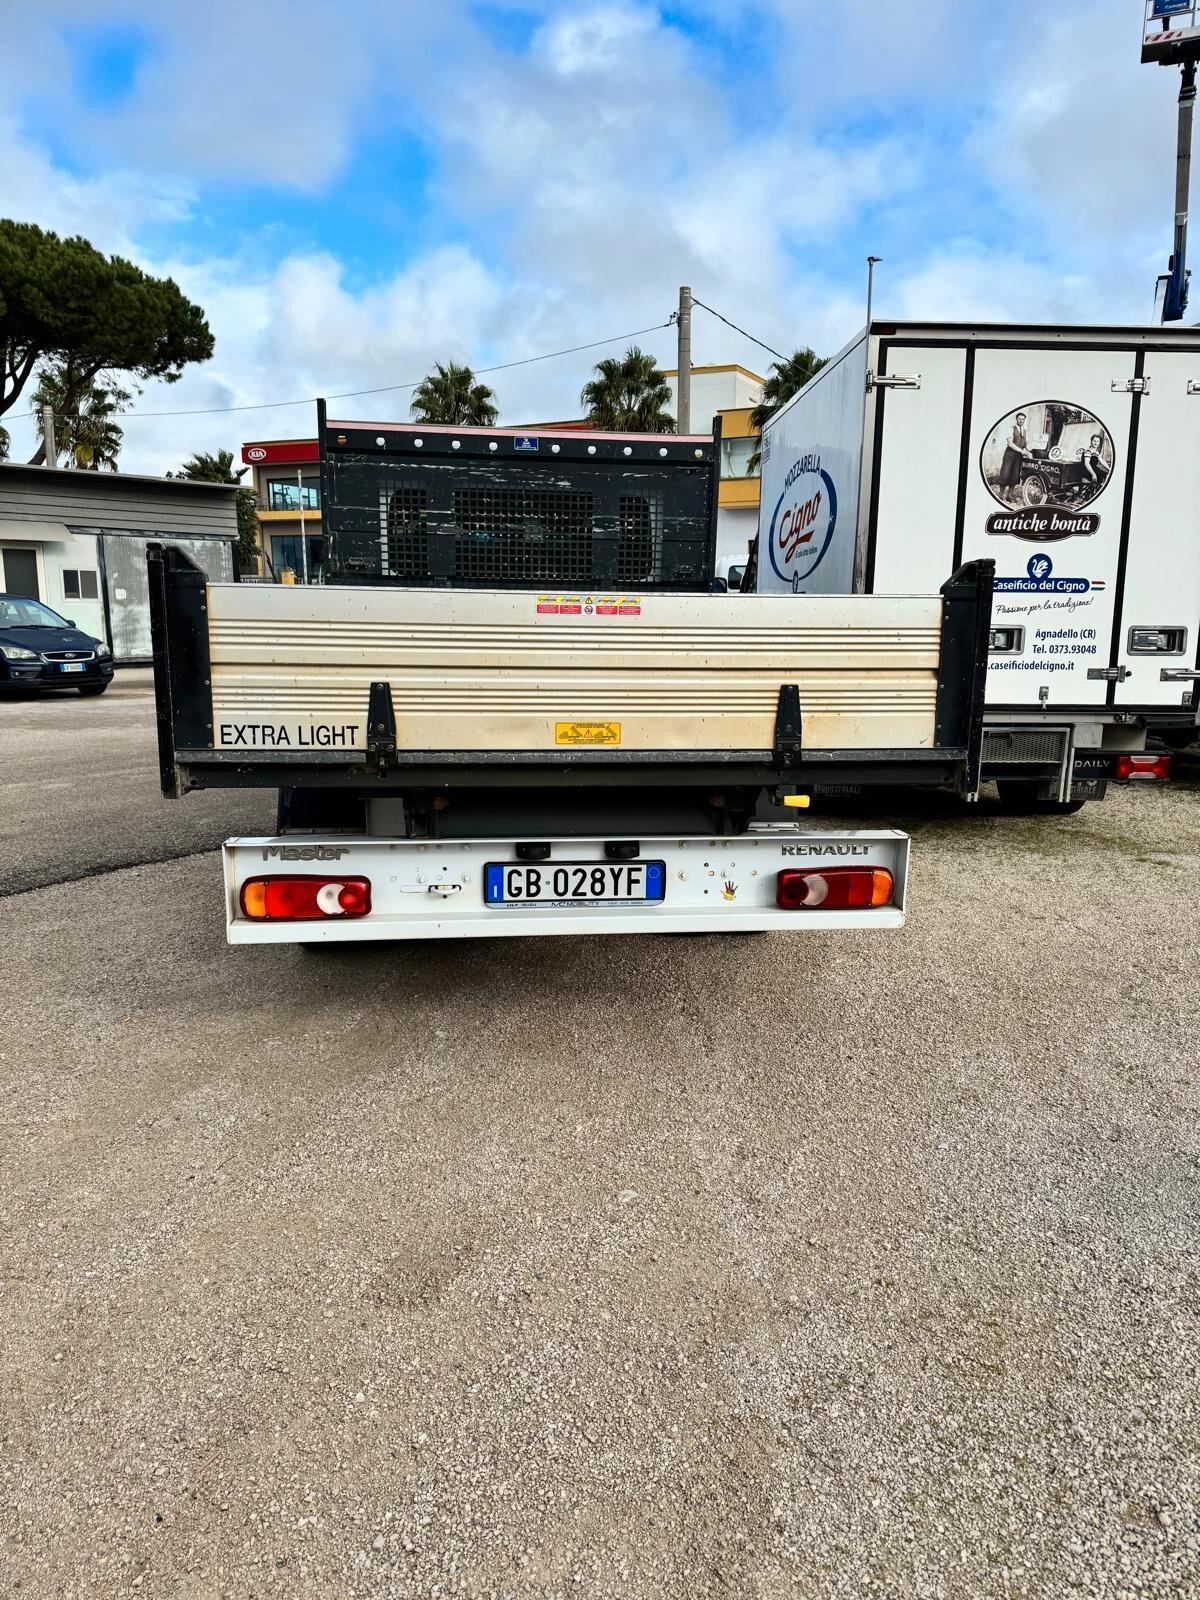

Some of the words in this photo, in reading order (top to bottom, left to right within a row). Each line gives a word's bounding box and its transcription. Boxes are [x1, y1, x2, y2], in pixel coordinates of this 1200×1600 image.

[250, 450, 264, 458] KIA
[784, 453, 821, 494] MOZZARELLA
[778, 490, 822, 564] Cigno
[993, 512, 1048, 532] antiche
[1050, 513, 1092, 532] bontà
[1039, 580, 1055, 590] del
[1056, 580, 1086, 593] Cigno
[995, 604, 1028, 615] Passione
[1027, 604, 1042, 616] per
[1043, 599, 1053, 610] la
[1052, 596, 1095, 613] tradizione!
[1035, 628, 1078, 641] Agnadello
[1079, 629, 1096, 640] (CR)
[1032, 644, 1047, 654] Tel.
[1049, 645, 1097, 654] 0373.93048
[219, 724, 291, 746] EXTRA
[297, 724, 360, 747] LIGHT
[1074, 760, 1111, 768] DAILY
[262, 845, 351, 862] Master
[781, 843, 873, 856] RENAULT
[506, 868, 542, 898] GB
[553, 867, 643, 897] 028YF
